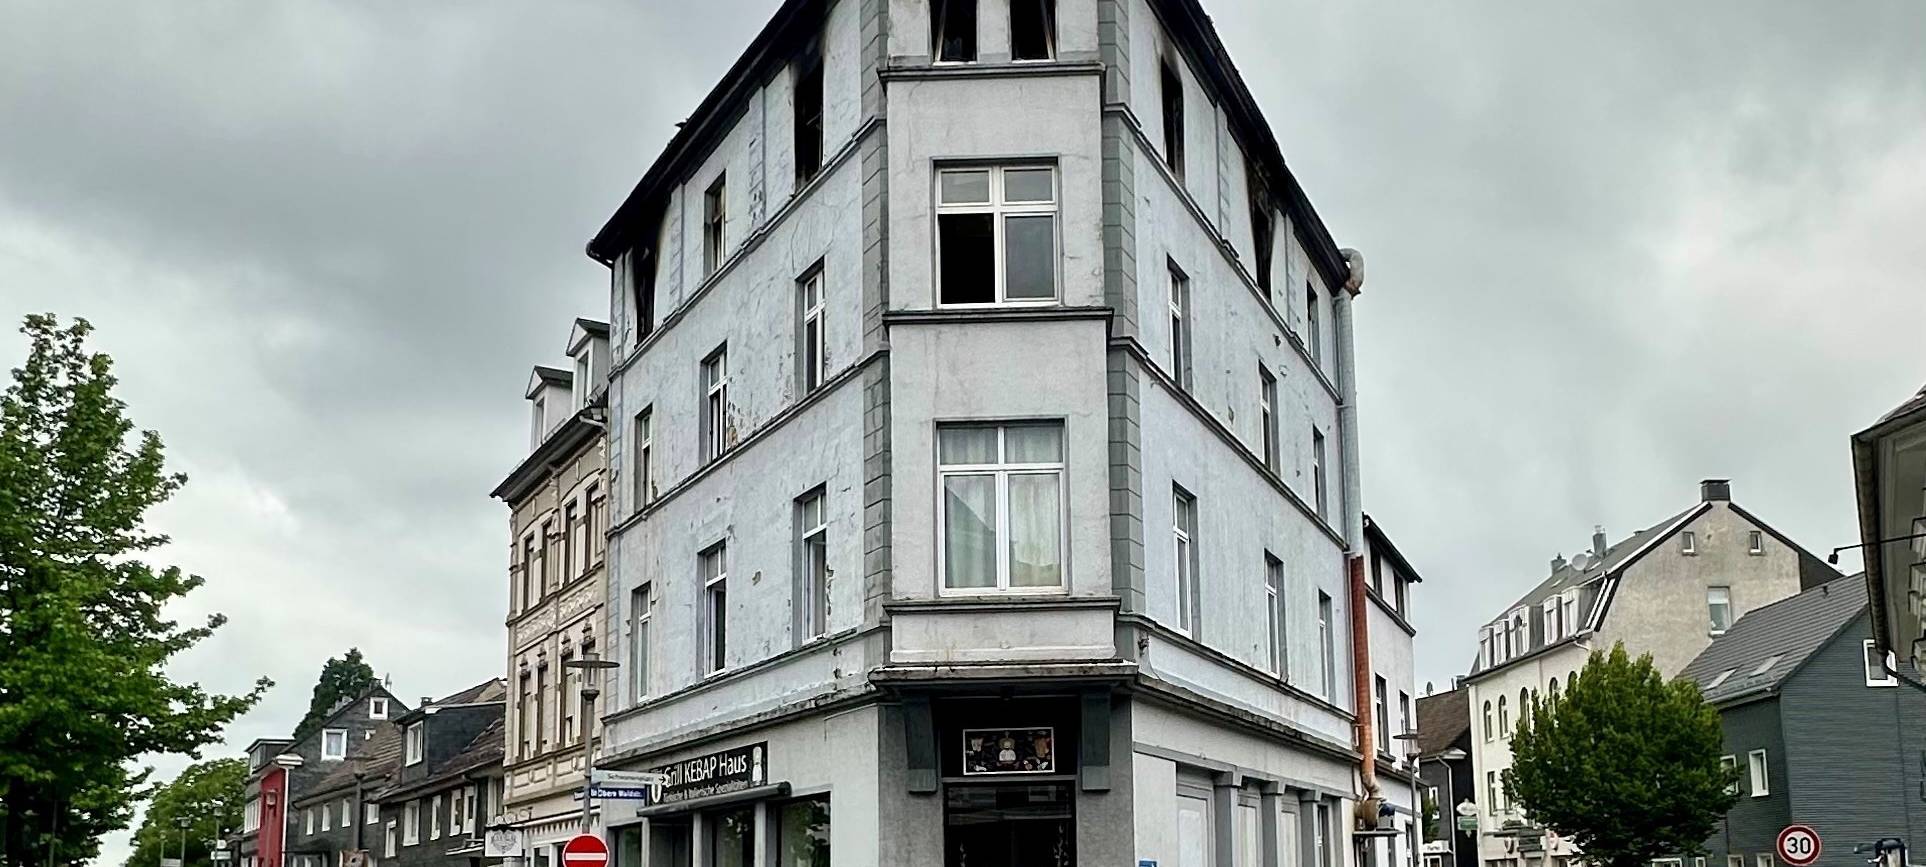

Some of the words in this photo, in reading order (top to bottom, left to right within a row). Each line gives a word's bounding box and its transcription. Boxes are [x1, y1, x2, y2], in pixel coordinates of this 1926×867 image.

[684, 756, 717, 784] KEBAP
[719, 753, 747, 777] Haus
[1787, 837, 1811, 854] 30
